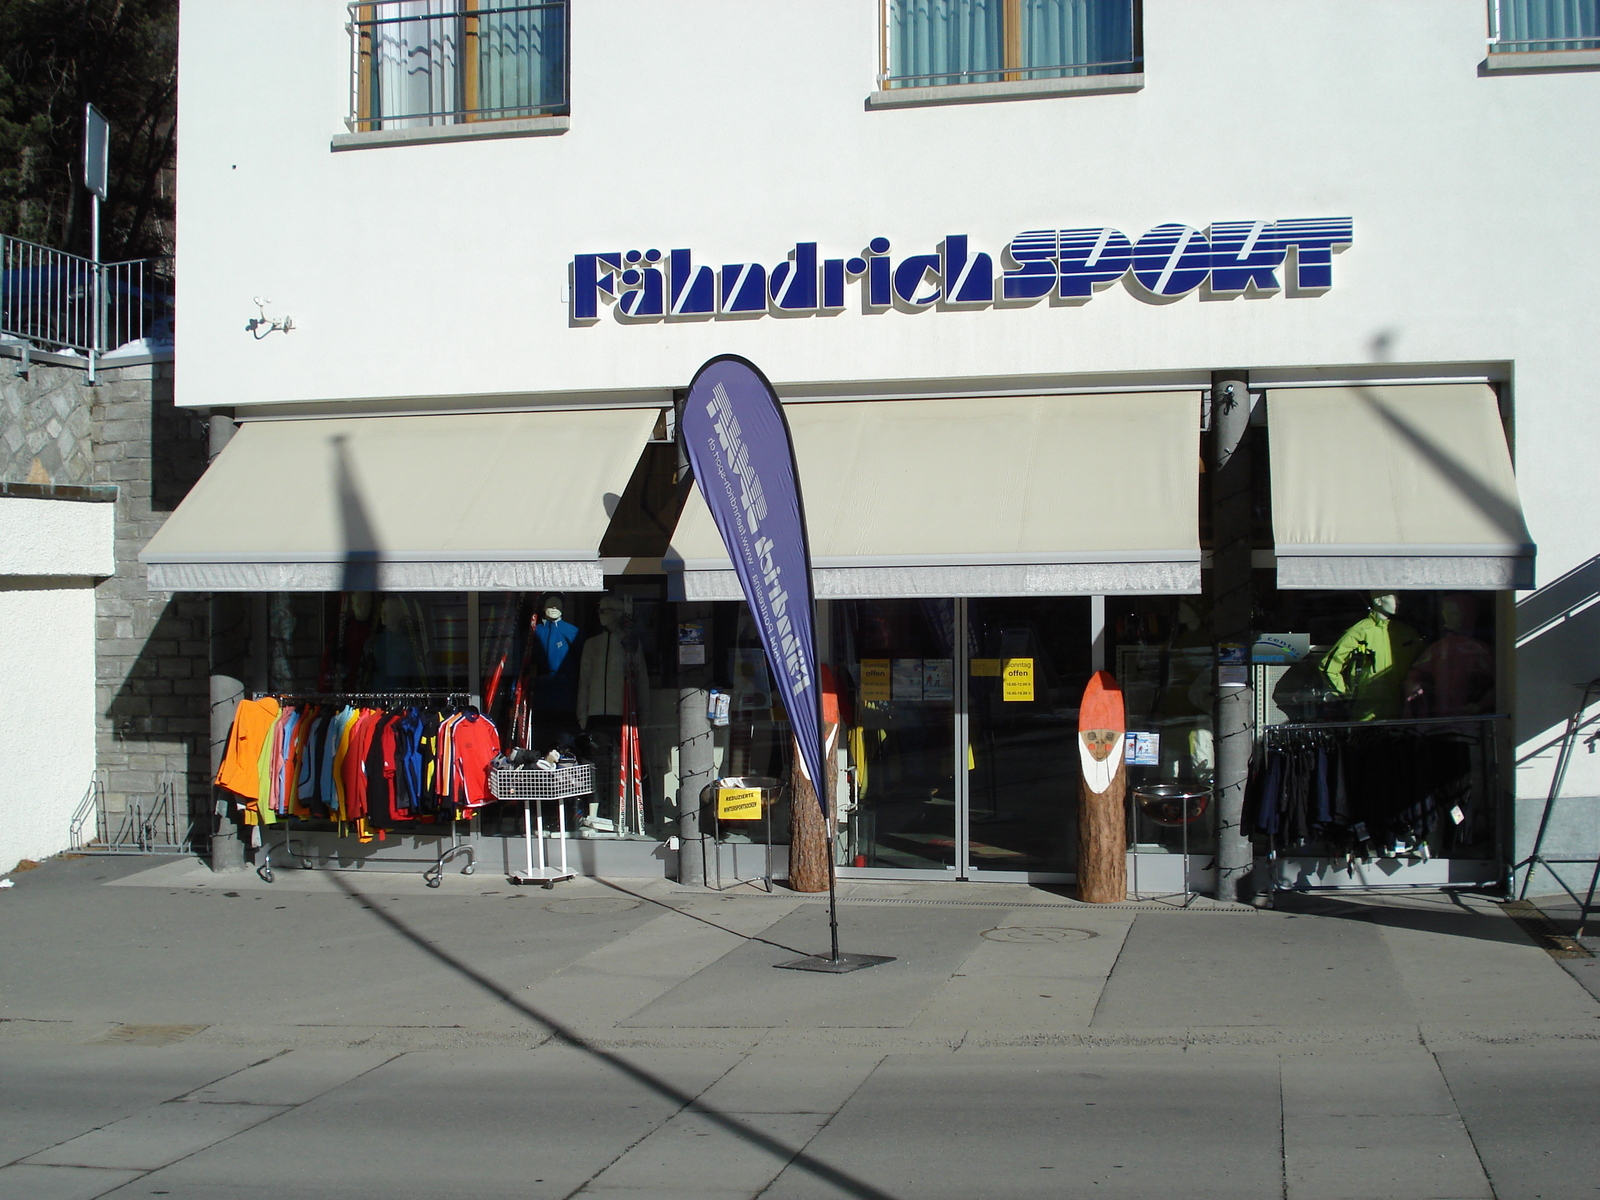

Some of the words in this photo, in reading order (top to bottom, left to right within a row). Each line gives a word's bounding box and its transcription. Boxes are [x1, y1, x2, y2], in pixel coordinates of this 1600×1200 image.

[1006, 661, 1032, 669] Sonntag
[865, 669, 885, 677] offen
[1008, 669, 1029, 677] offen
